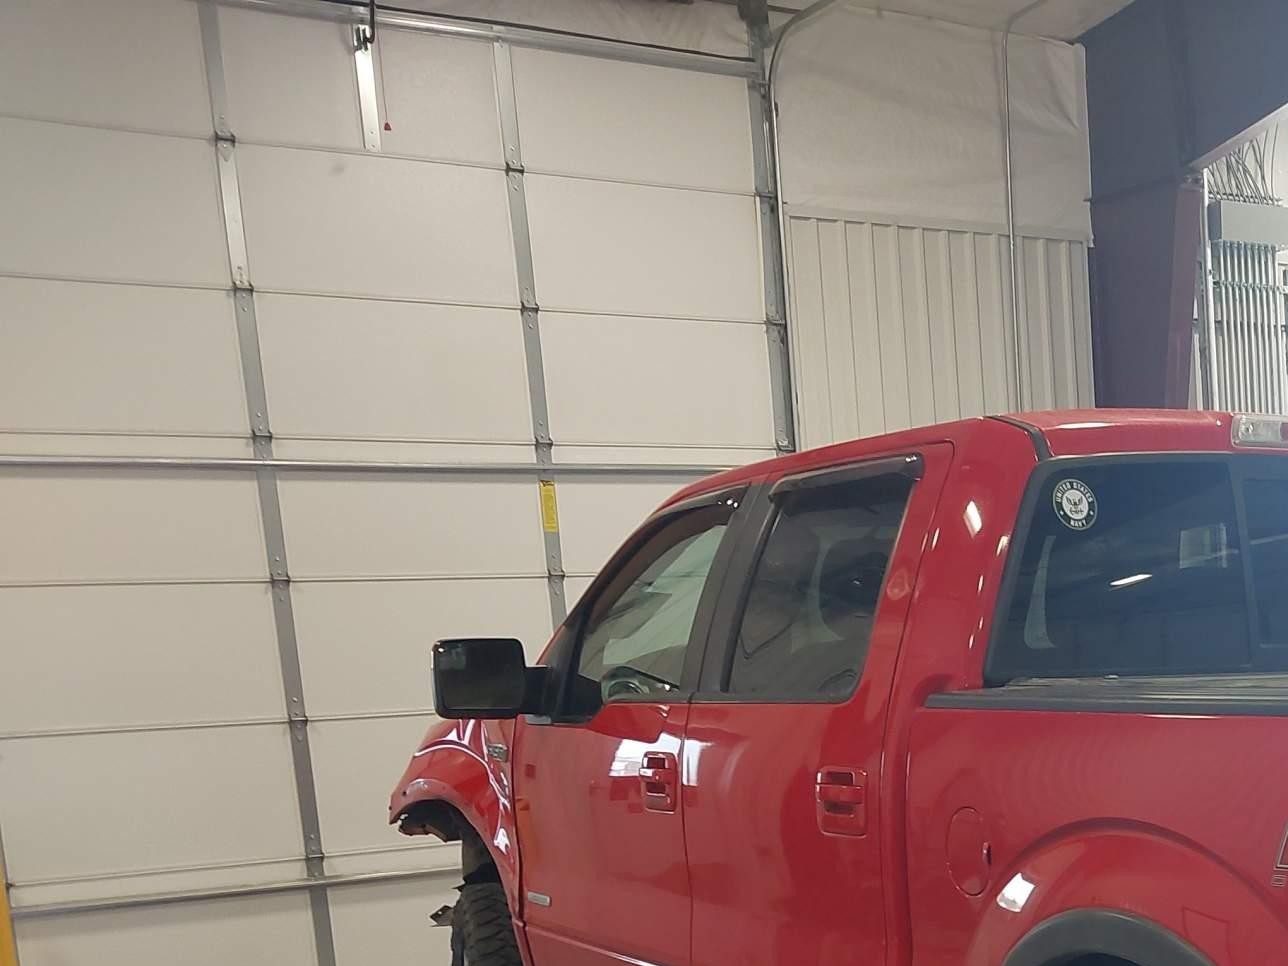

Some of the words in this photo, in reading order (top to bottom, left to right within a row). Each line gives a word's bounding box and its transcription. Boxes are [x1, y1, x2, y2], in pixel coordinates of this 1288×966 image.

[1056, 482, 1071, 502] UNITED
[1073, 482, 1093, 502] STATES
[1070, 519, 1086, 527] NAVY
